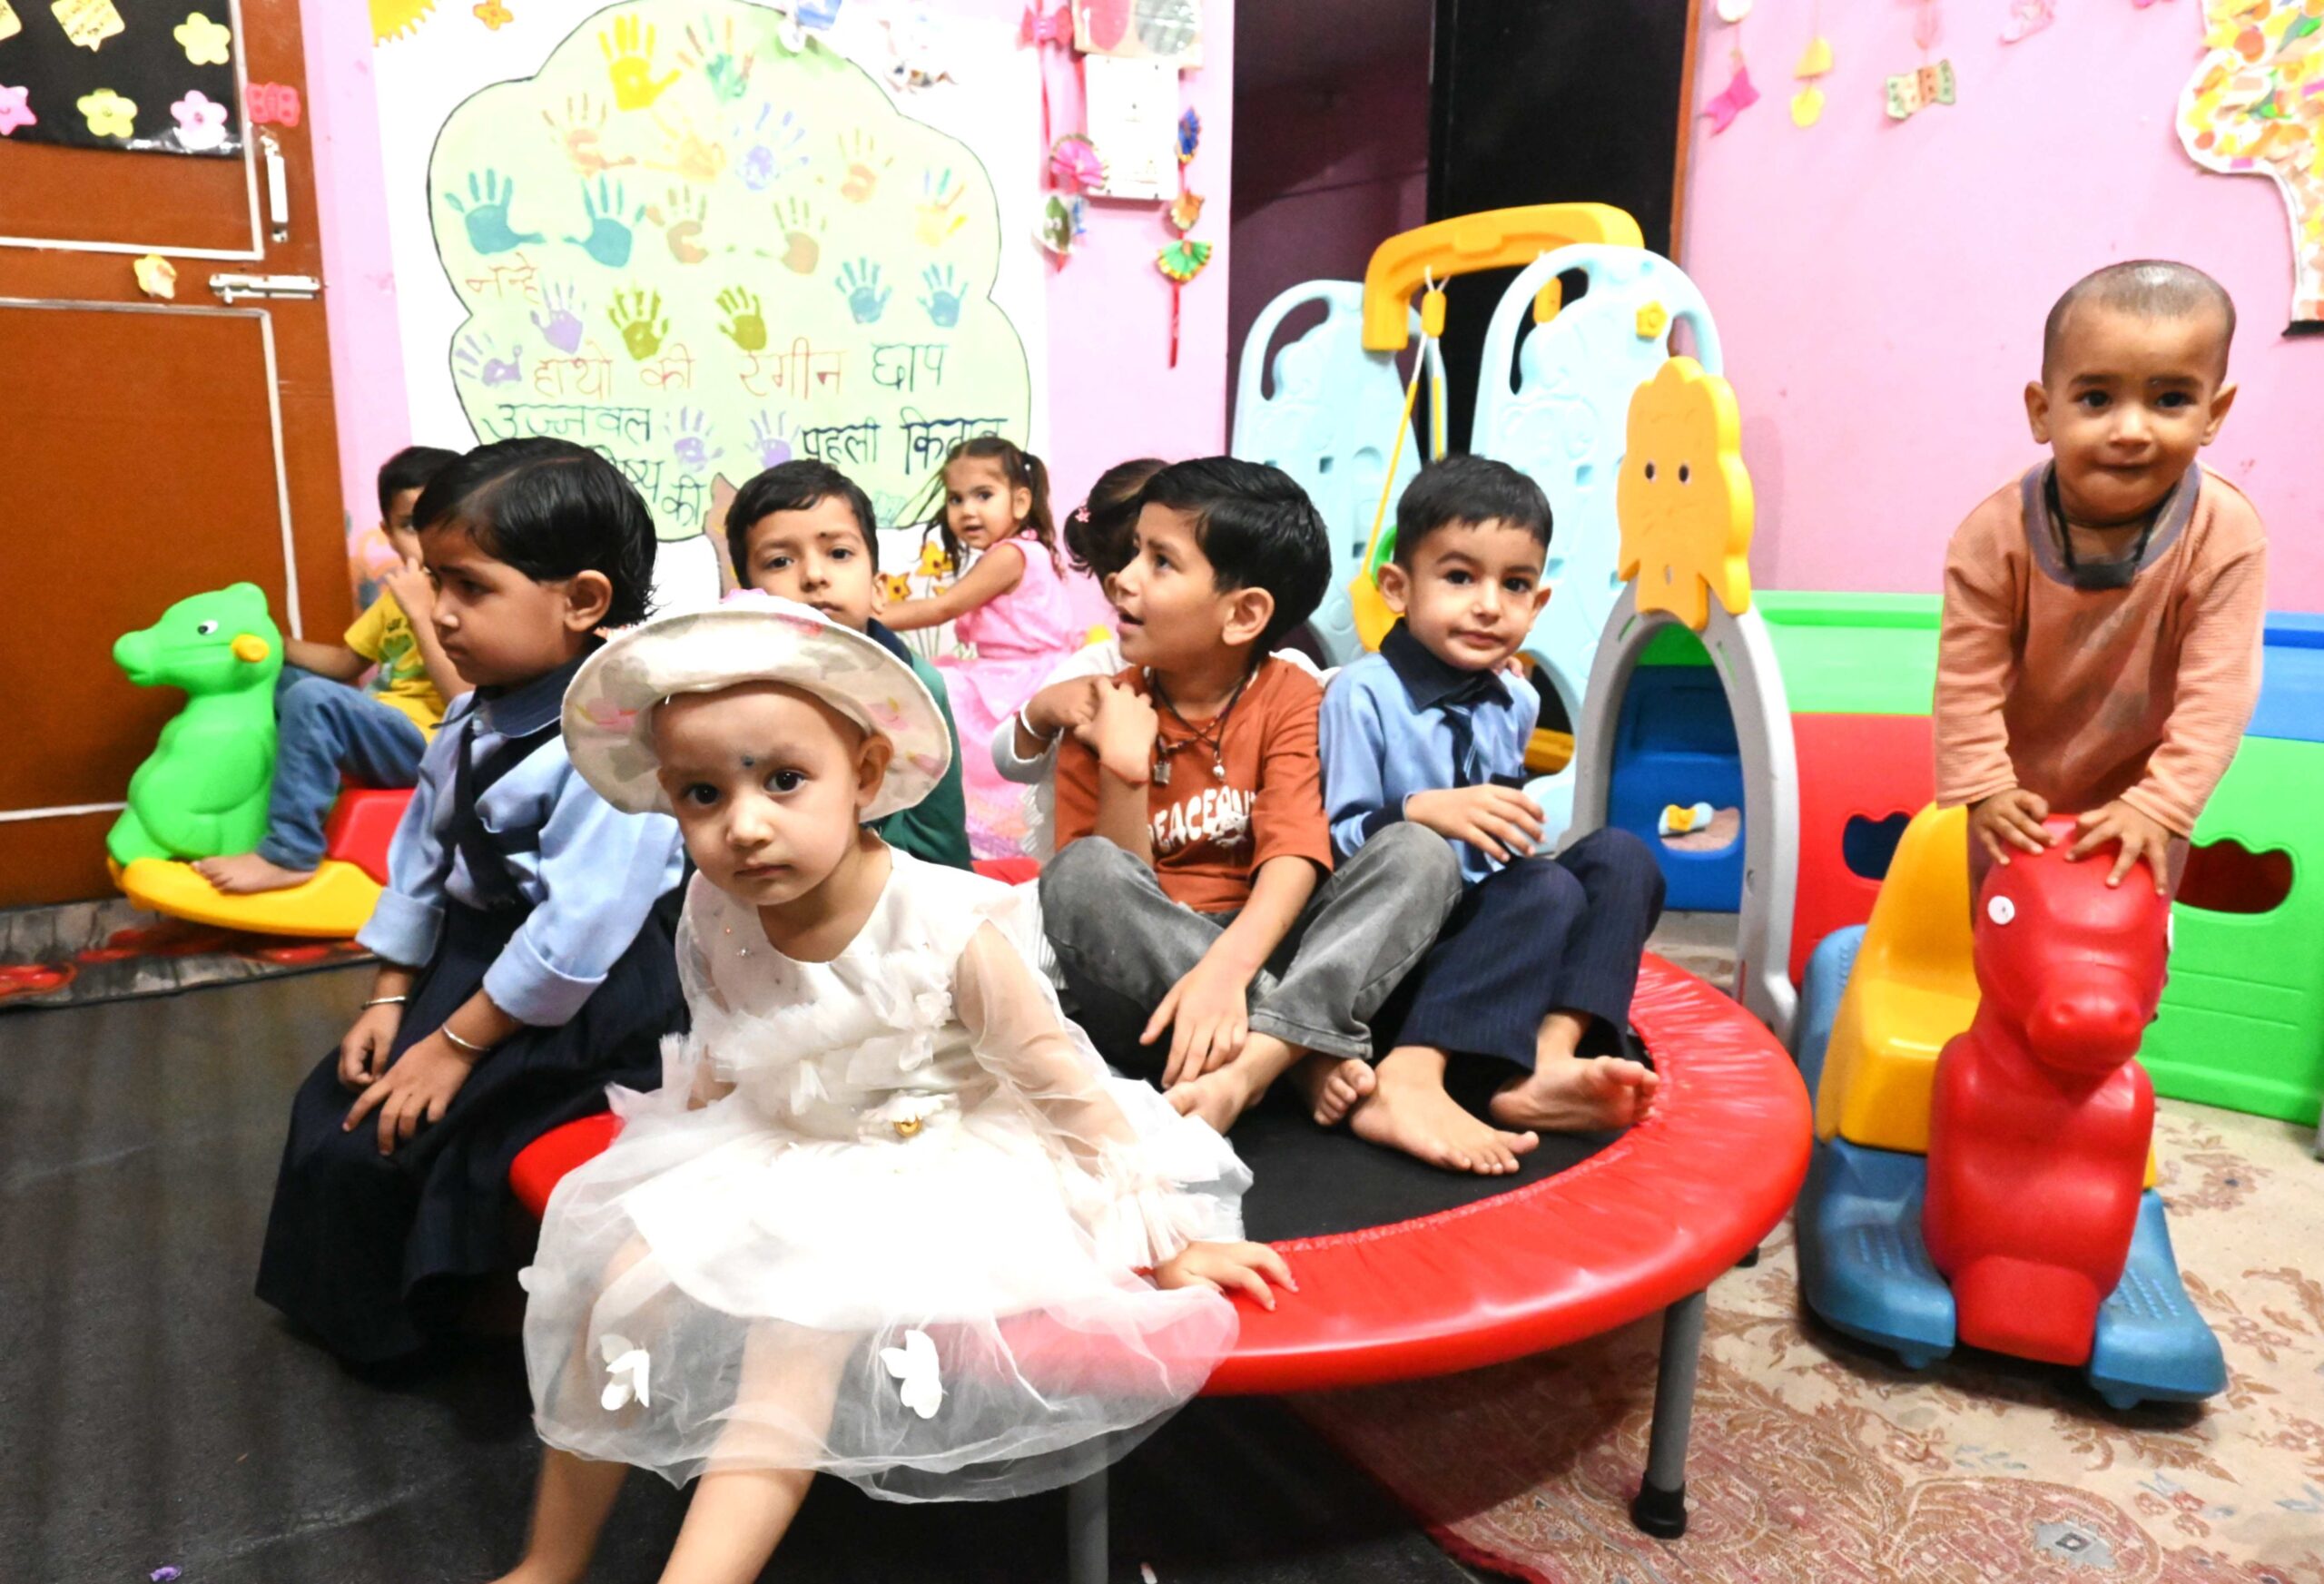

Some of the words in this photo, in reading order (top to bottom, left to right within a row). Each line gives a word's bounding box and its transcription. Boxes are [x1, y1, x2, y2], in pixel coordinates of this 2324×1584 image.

[640, 342, 696, 391] की
[870, 341, 950, 392] छाप
[802, 417, 881, 464] पहली
[662, 474, 707, 526] की
